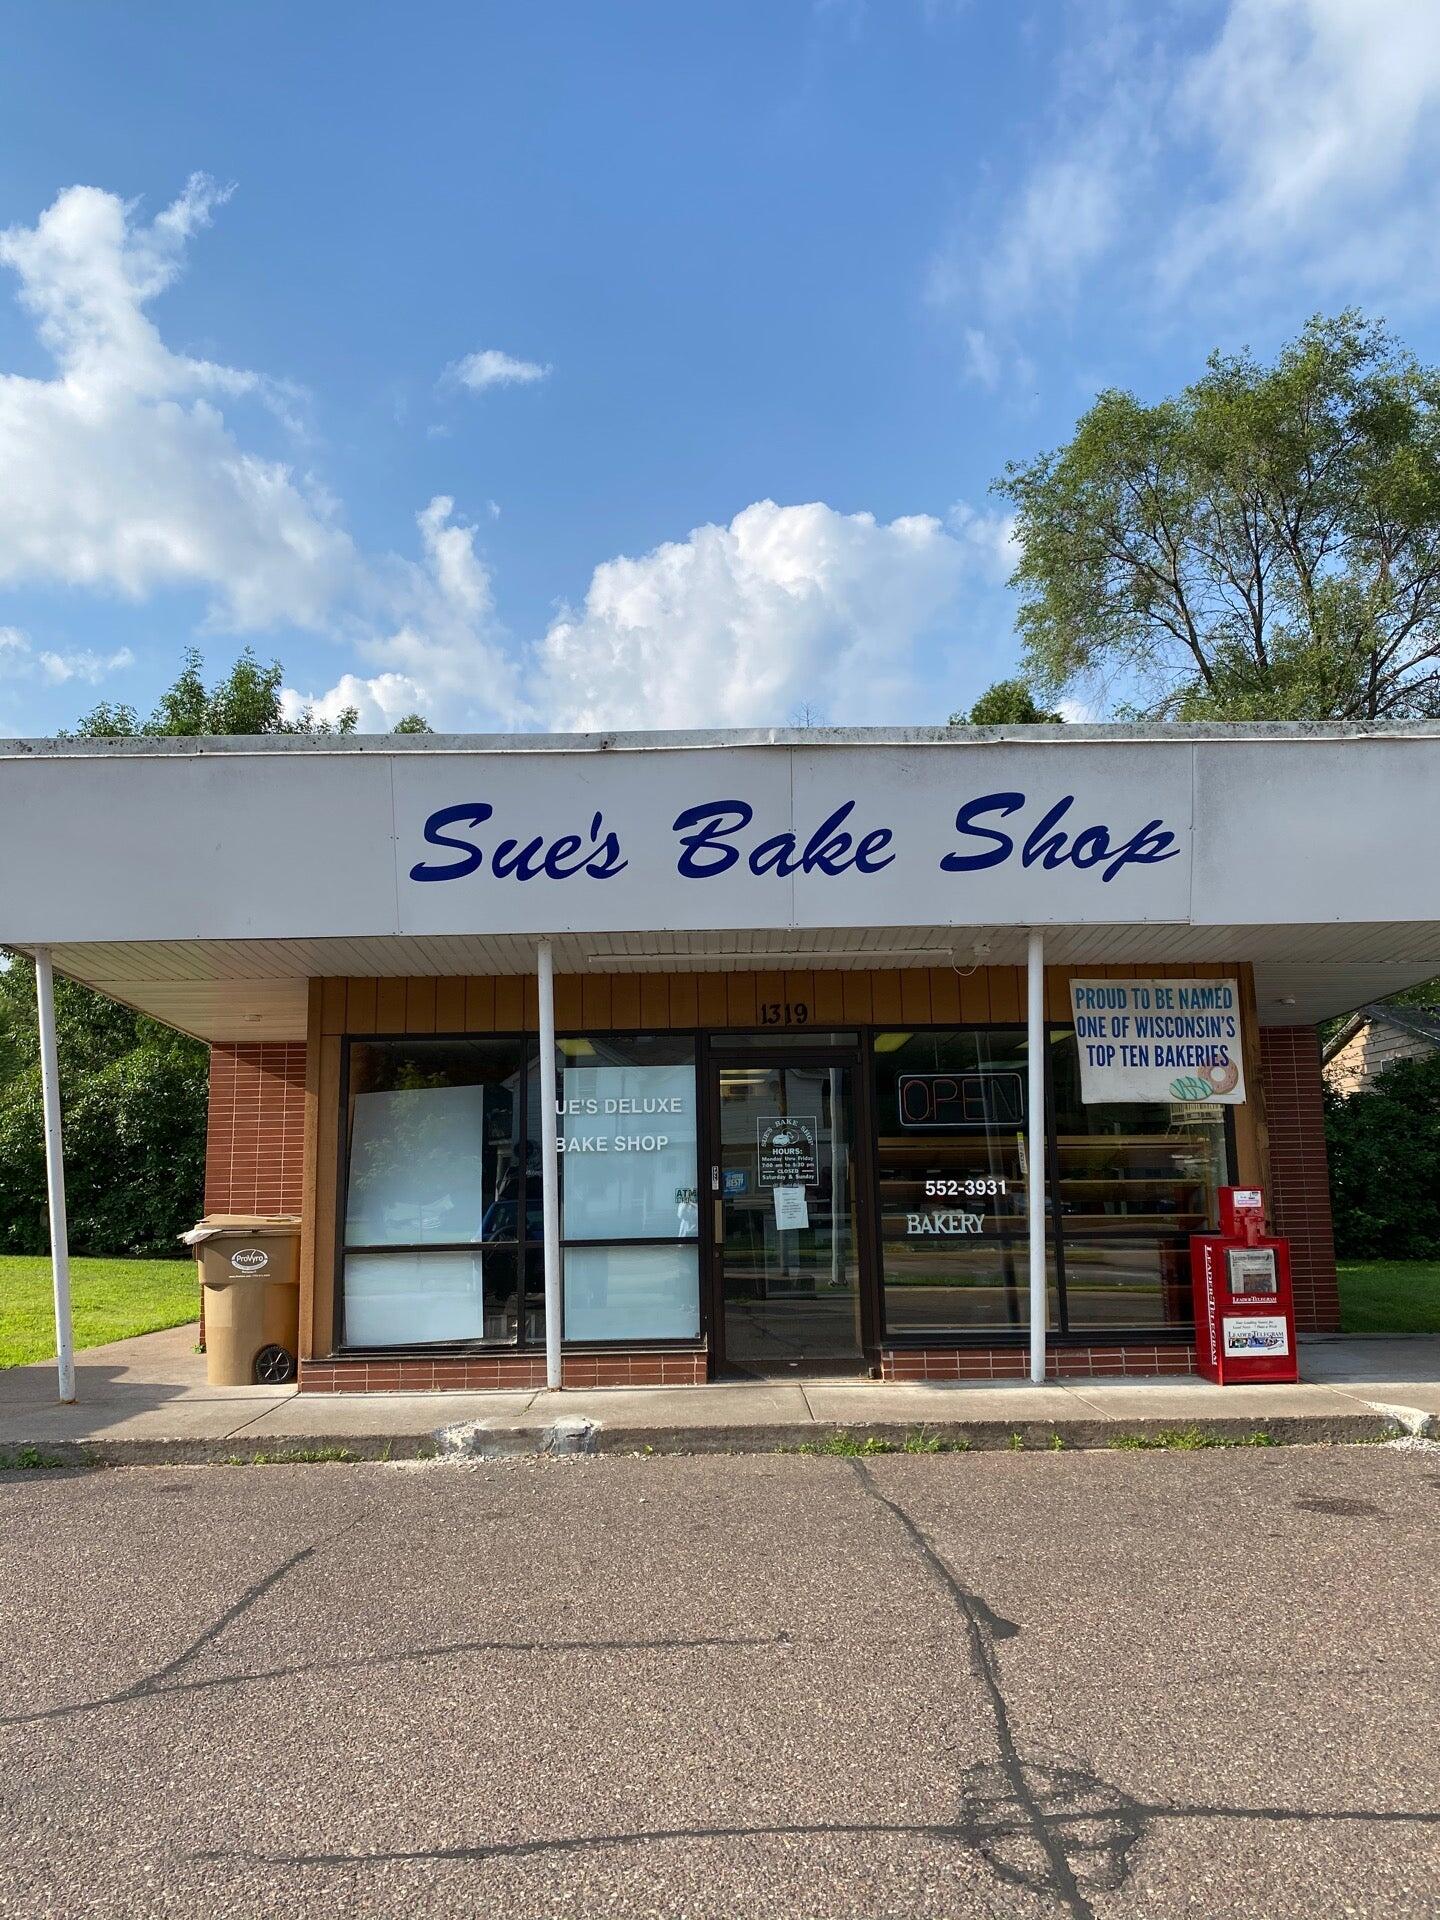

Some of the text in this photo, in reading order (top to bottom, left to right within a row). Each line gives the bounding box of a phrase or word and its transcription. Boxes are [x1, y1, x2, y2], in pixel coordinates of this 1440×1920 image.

[409, 792, 1180, 883] Sue's Bake Shop
[1075, 986, 1232, 1010] PROUD TO BE NAMED
[761, 1003, 808, 1025] 1319
[1076, 1016, 1236, 1038] ONE OF WISCONSIN'S
[1086, 1045, 1229, 1067] TOP TEN BAKERIES
[555, 1097, 682, 1115] UE'S DELUXE
[903, 1078, 1018, 1121] OPEN
[774, 1118, 799, 1128] BAKE
[800, 1125, 814, 1146] SHOP
[555, 1135, 669, 1153] BAKE SHOP
[676, 1189, 697, 1197] ATM
[925, 1180, 1006, 1196] 552-3931
[906, 1214, 985, 1234] BAKERY
